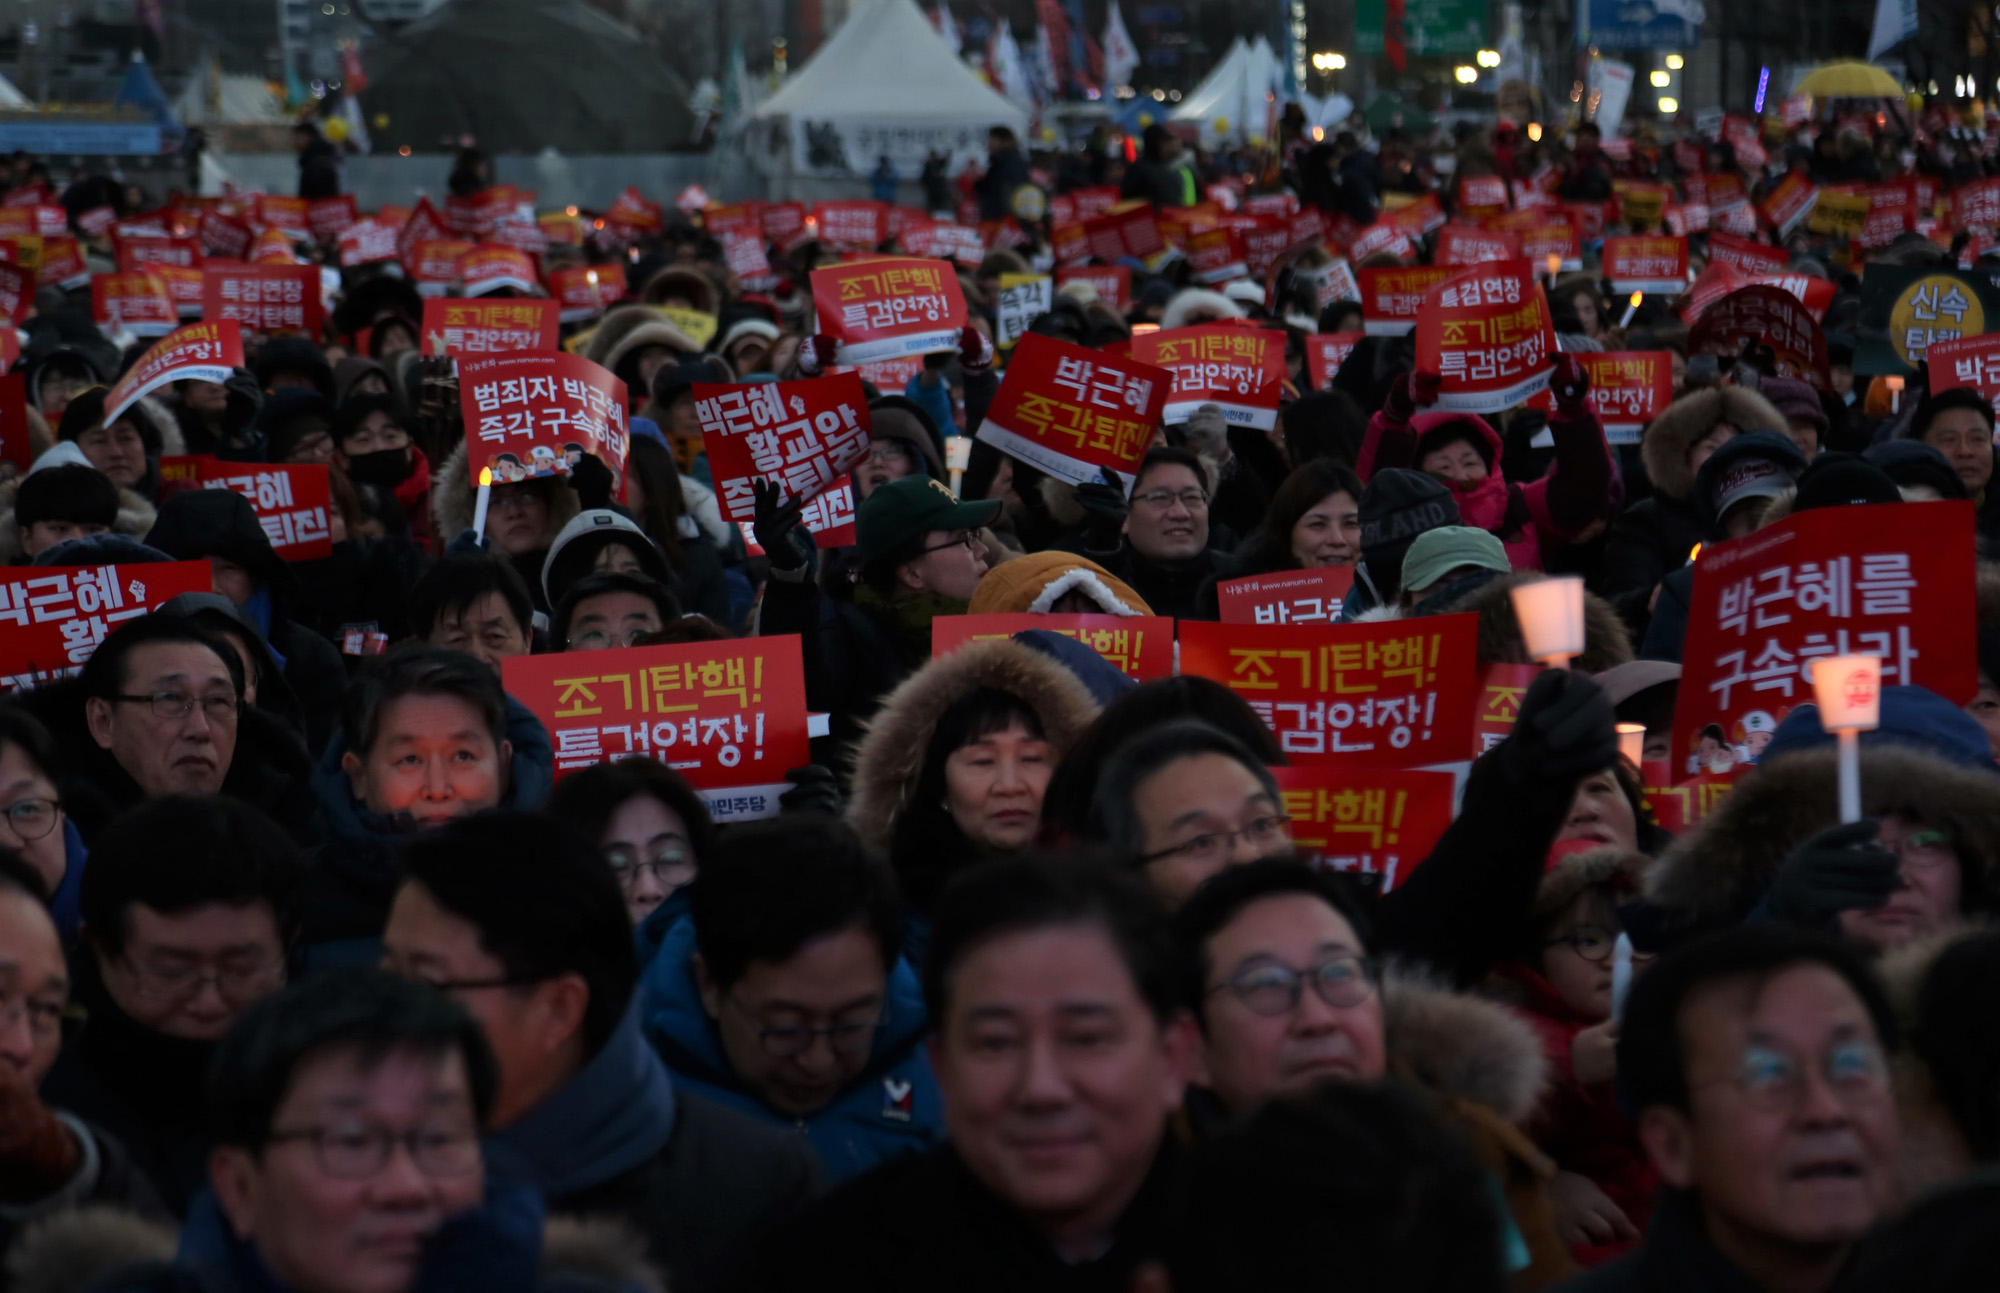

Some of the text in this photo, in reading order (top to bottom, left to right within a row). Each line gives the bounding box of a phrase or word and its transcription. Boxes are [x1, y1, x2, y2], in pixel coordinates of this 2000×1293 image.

[220, 278, 304, 303] 특검연장
[838, 267, 943, 302] 조기탄핵!
[1440, 275, 1521, 307] 특검연장
[1909, 284, 1969, 323] 신속
[443, 305, 543, 330] 조기탄핵!
[842, 294, 950, 330] 특검연장!
[1440, 296, 1543, 345] 조기탄핵!
[1156, 335, 1266, 366] 조기탄핵!
[1439, 329, 1546, 382] 특검연장!
[473, 375, 624, 431] 범죄자 박근혜
[694, 381, 788, 437] 박근혜
[1053, 355, 1155, 416] 박근혜
[478, 410, 535, 444] 즉각
[744, 403, 858, 473] 황교안
[1015, 390, 1151, 462] 즉각퇴진
[0, 564, 124, 627] 박근혜
[1226, 577, 1323, 596] 나눔문화 www.nanum.com
[1717, 552, 1919, 637] 박근혜를
[553, 656, 764, 718] 조기탄핵!
[1229, 633, 1443, 694] 조기탄핵!
[1708, 625, 1920, 712] 구속하라
[553, 712, 765, 770] 특검연장!
